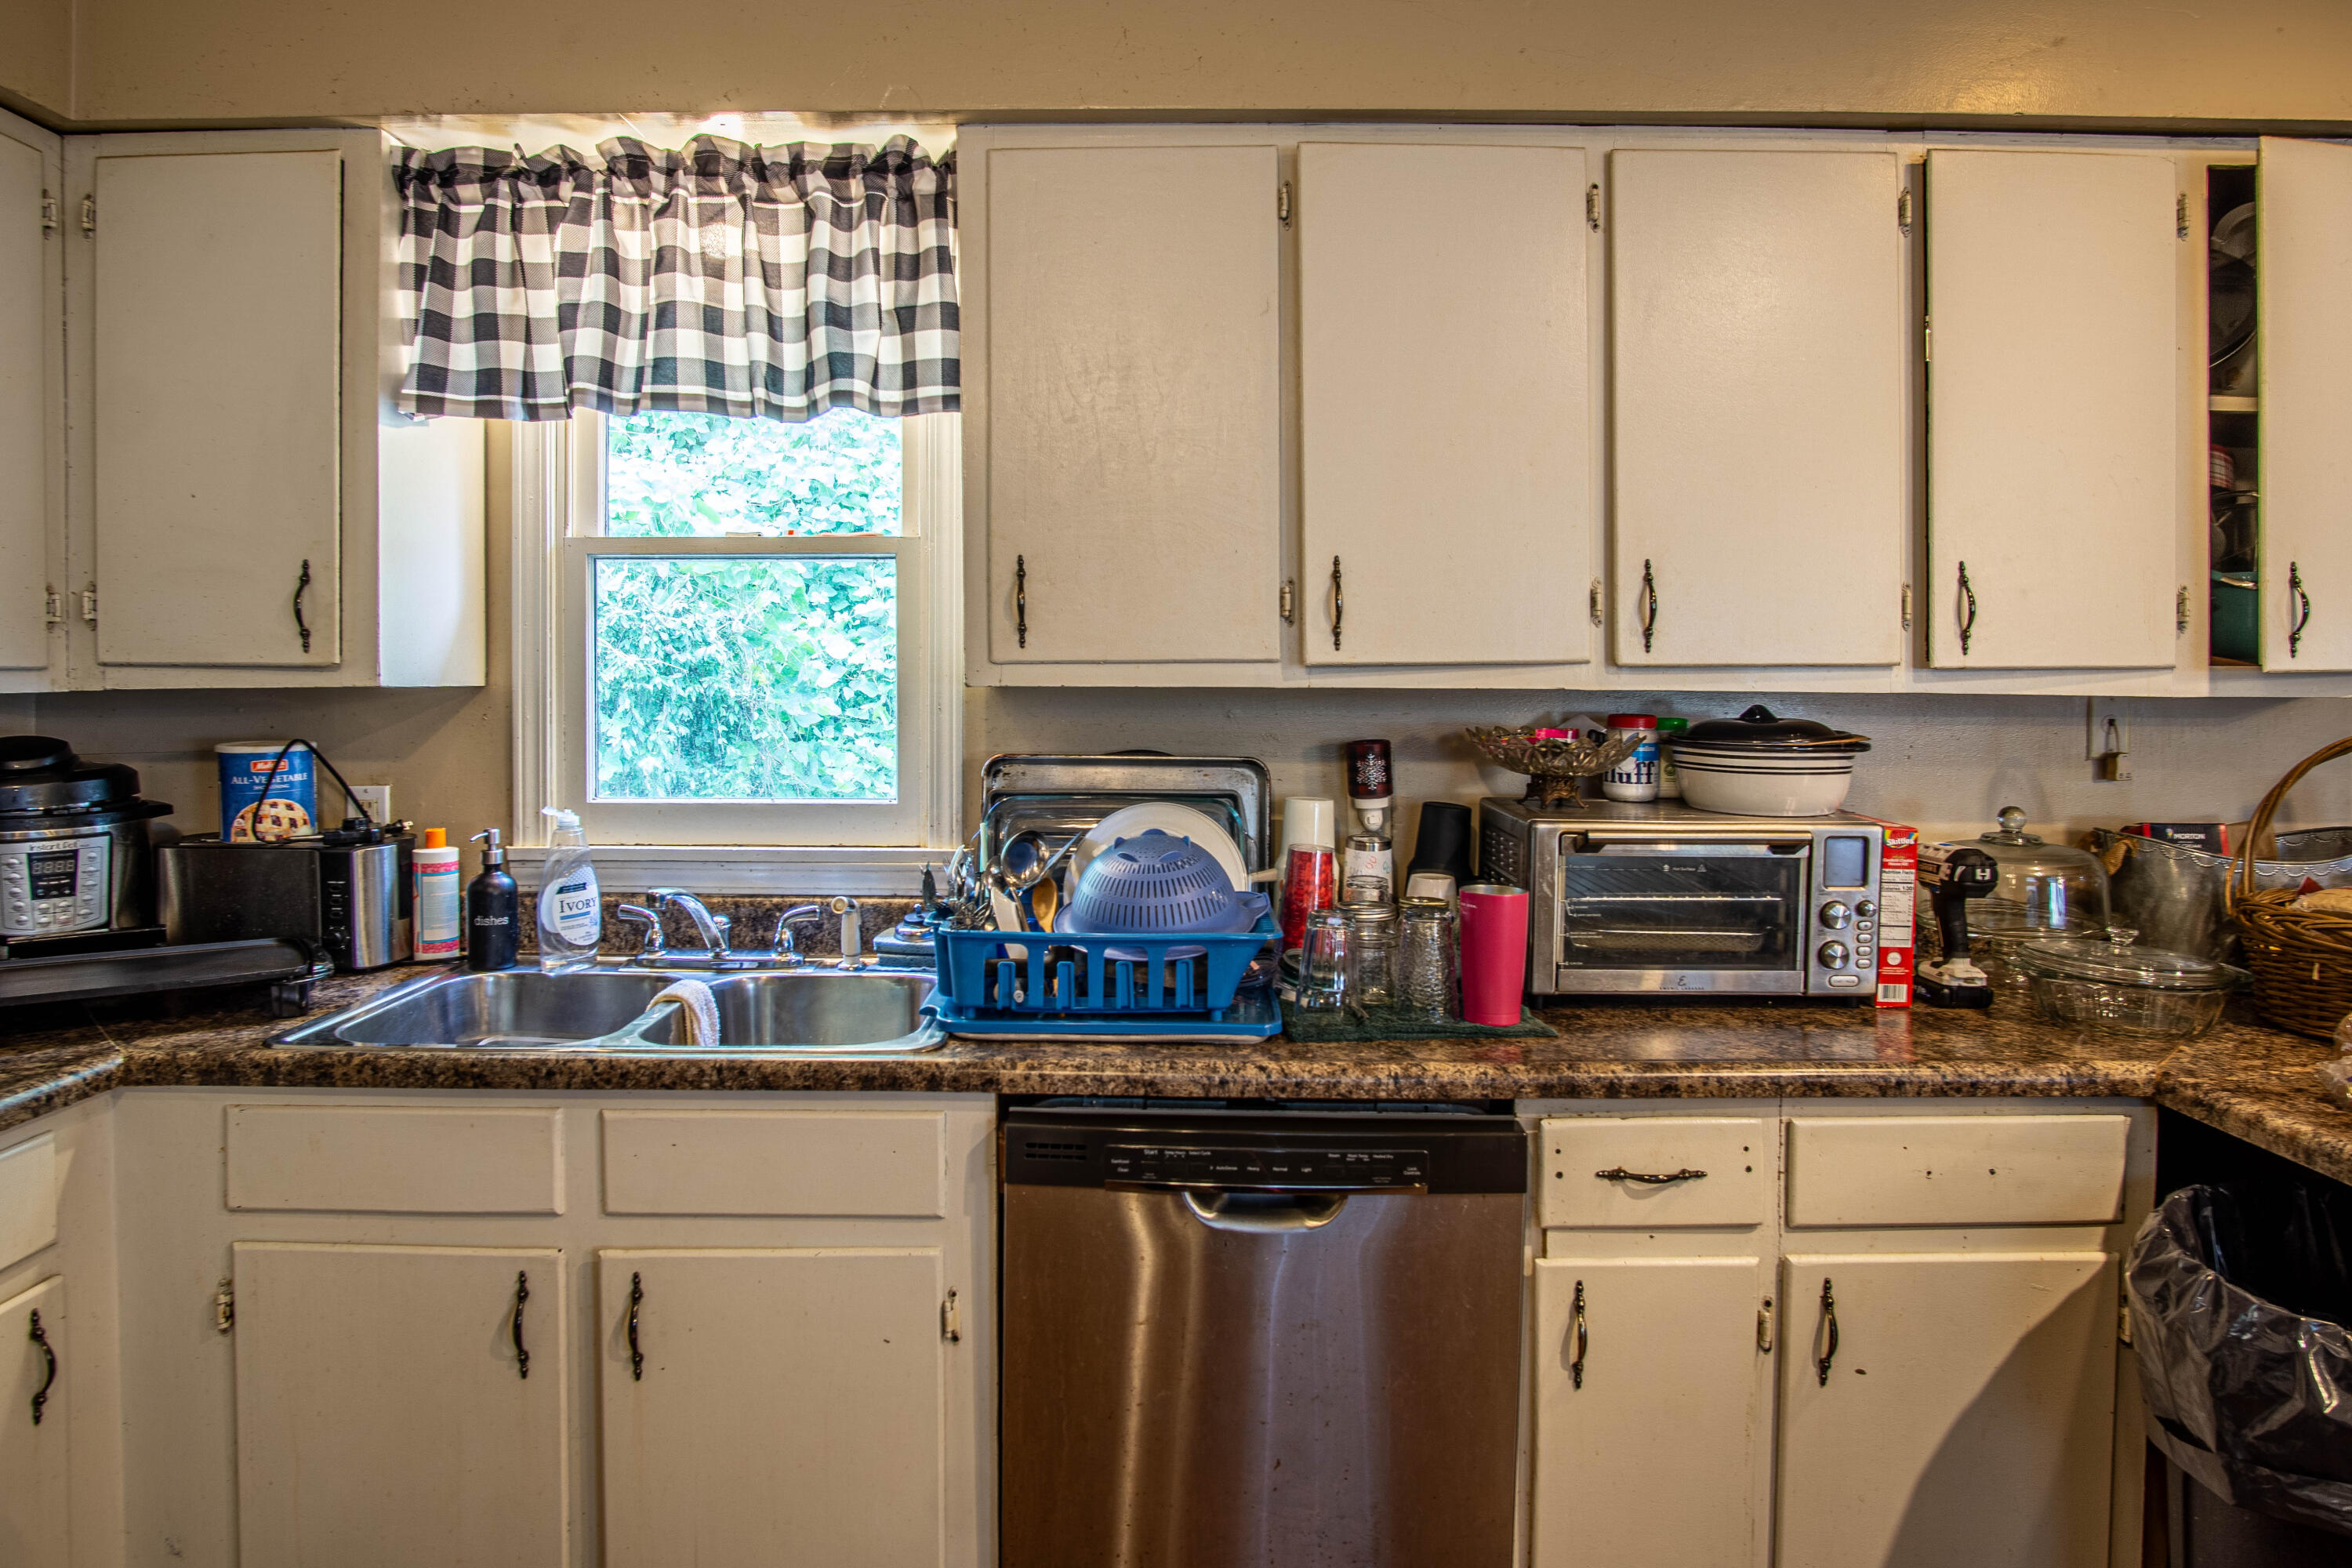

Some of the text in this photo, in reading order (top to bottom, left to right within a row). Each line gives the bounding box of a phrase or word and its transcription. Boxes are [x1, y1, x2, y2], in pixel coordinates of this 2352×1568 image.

[231, 772, 308, 784] ALL-VEETABLE
[1886, 837, 1915, 846] Skittles
[474, 915, 509, 926] dishes
